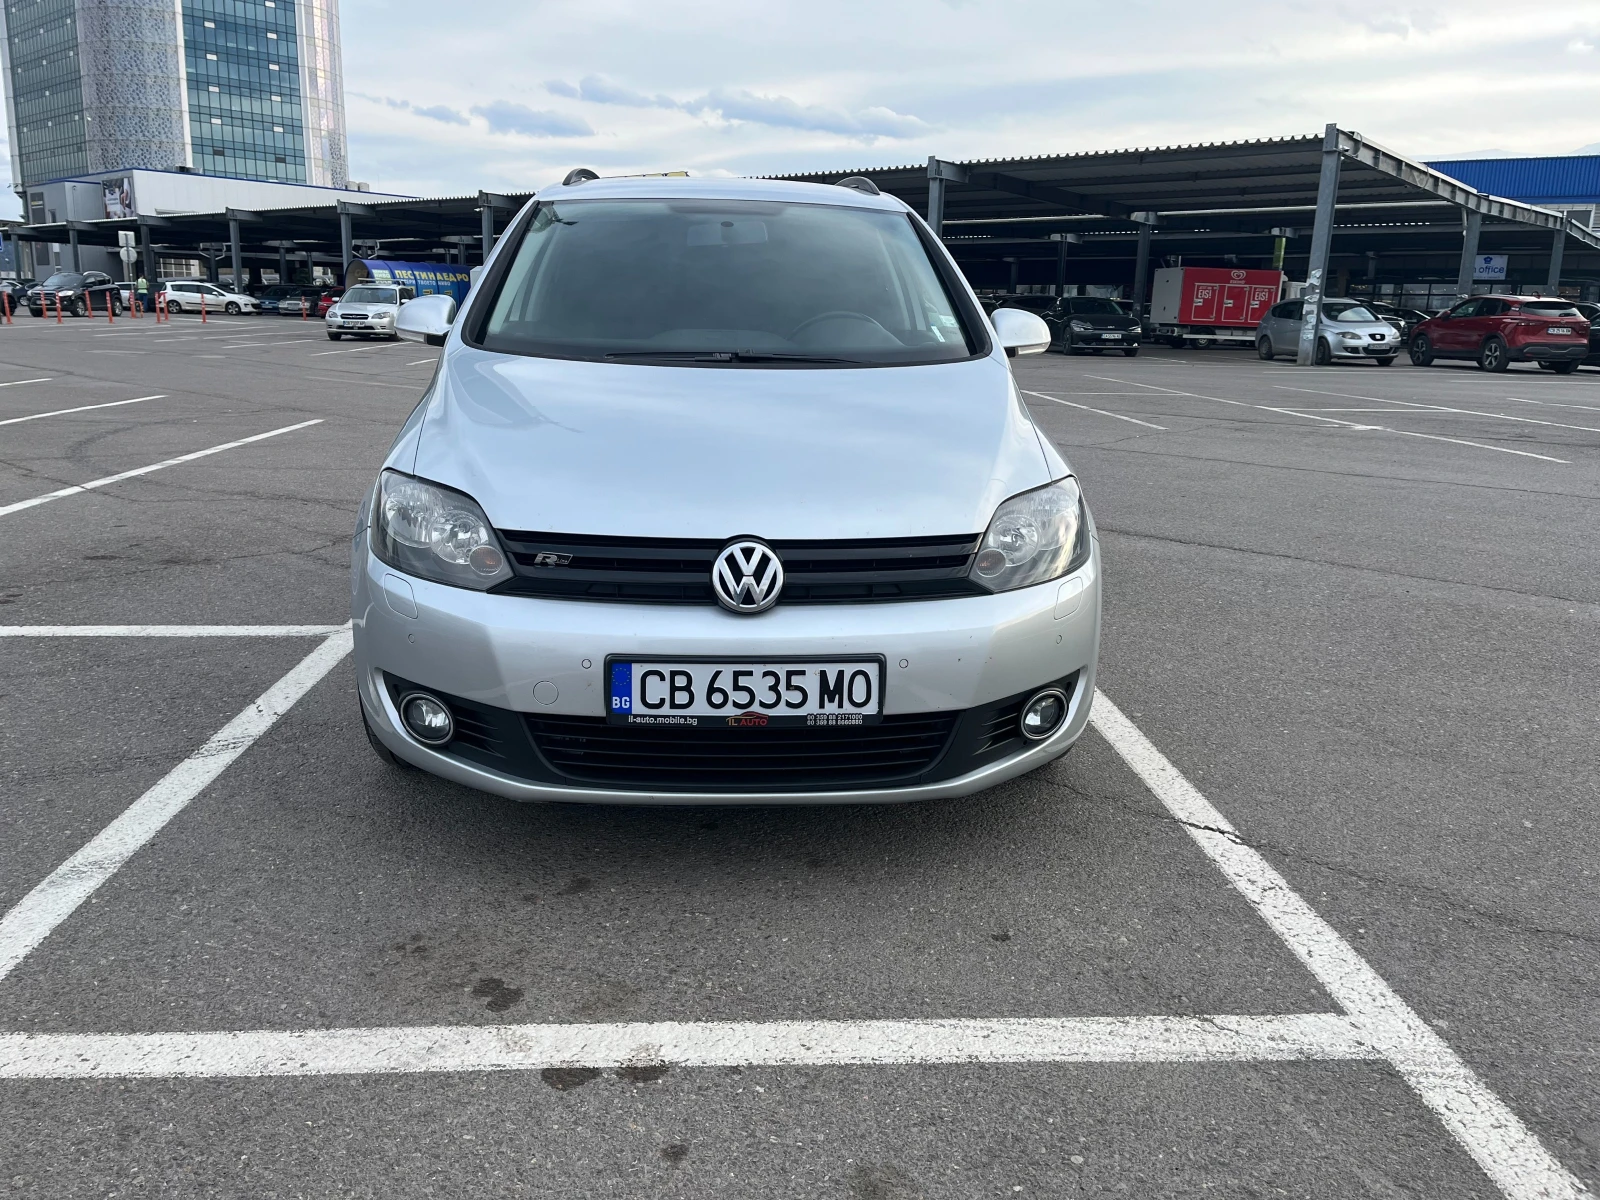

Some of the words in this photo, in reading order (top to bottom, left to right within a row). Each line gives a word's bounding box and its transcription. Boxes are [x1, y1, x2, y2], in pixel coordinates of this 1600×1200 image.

[1479, 265, 1505, 274] office
[1198, 289, 1212, 299] EIS!
[1255, 291, 1269, 301] EIS!
[640, 669, 695, 709] CB
[706, 669, 809, 709] 6535
[612, 696, 630, 708] BG
[628, 715, 698, 725] il-auto.mobile.bg
[740, 718, 768, 726] AUTO
